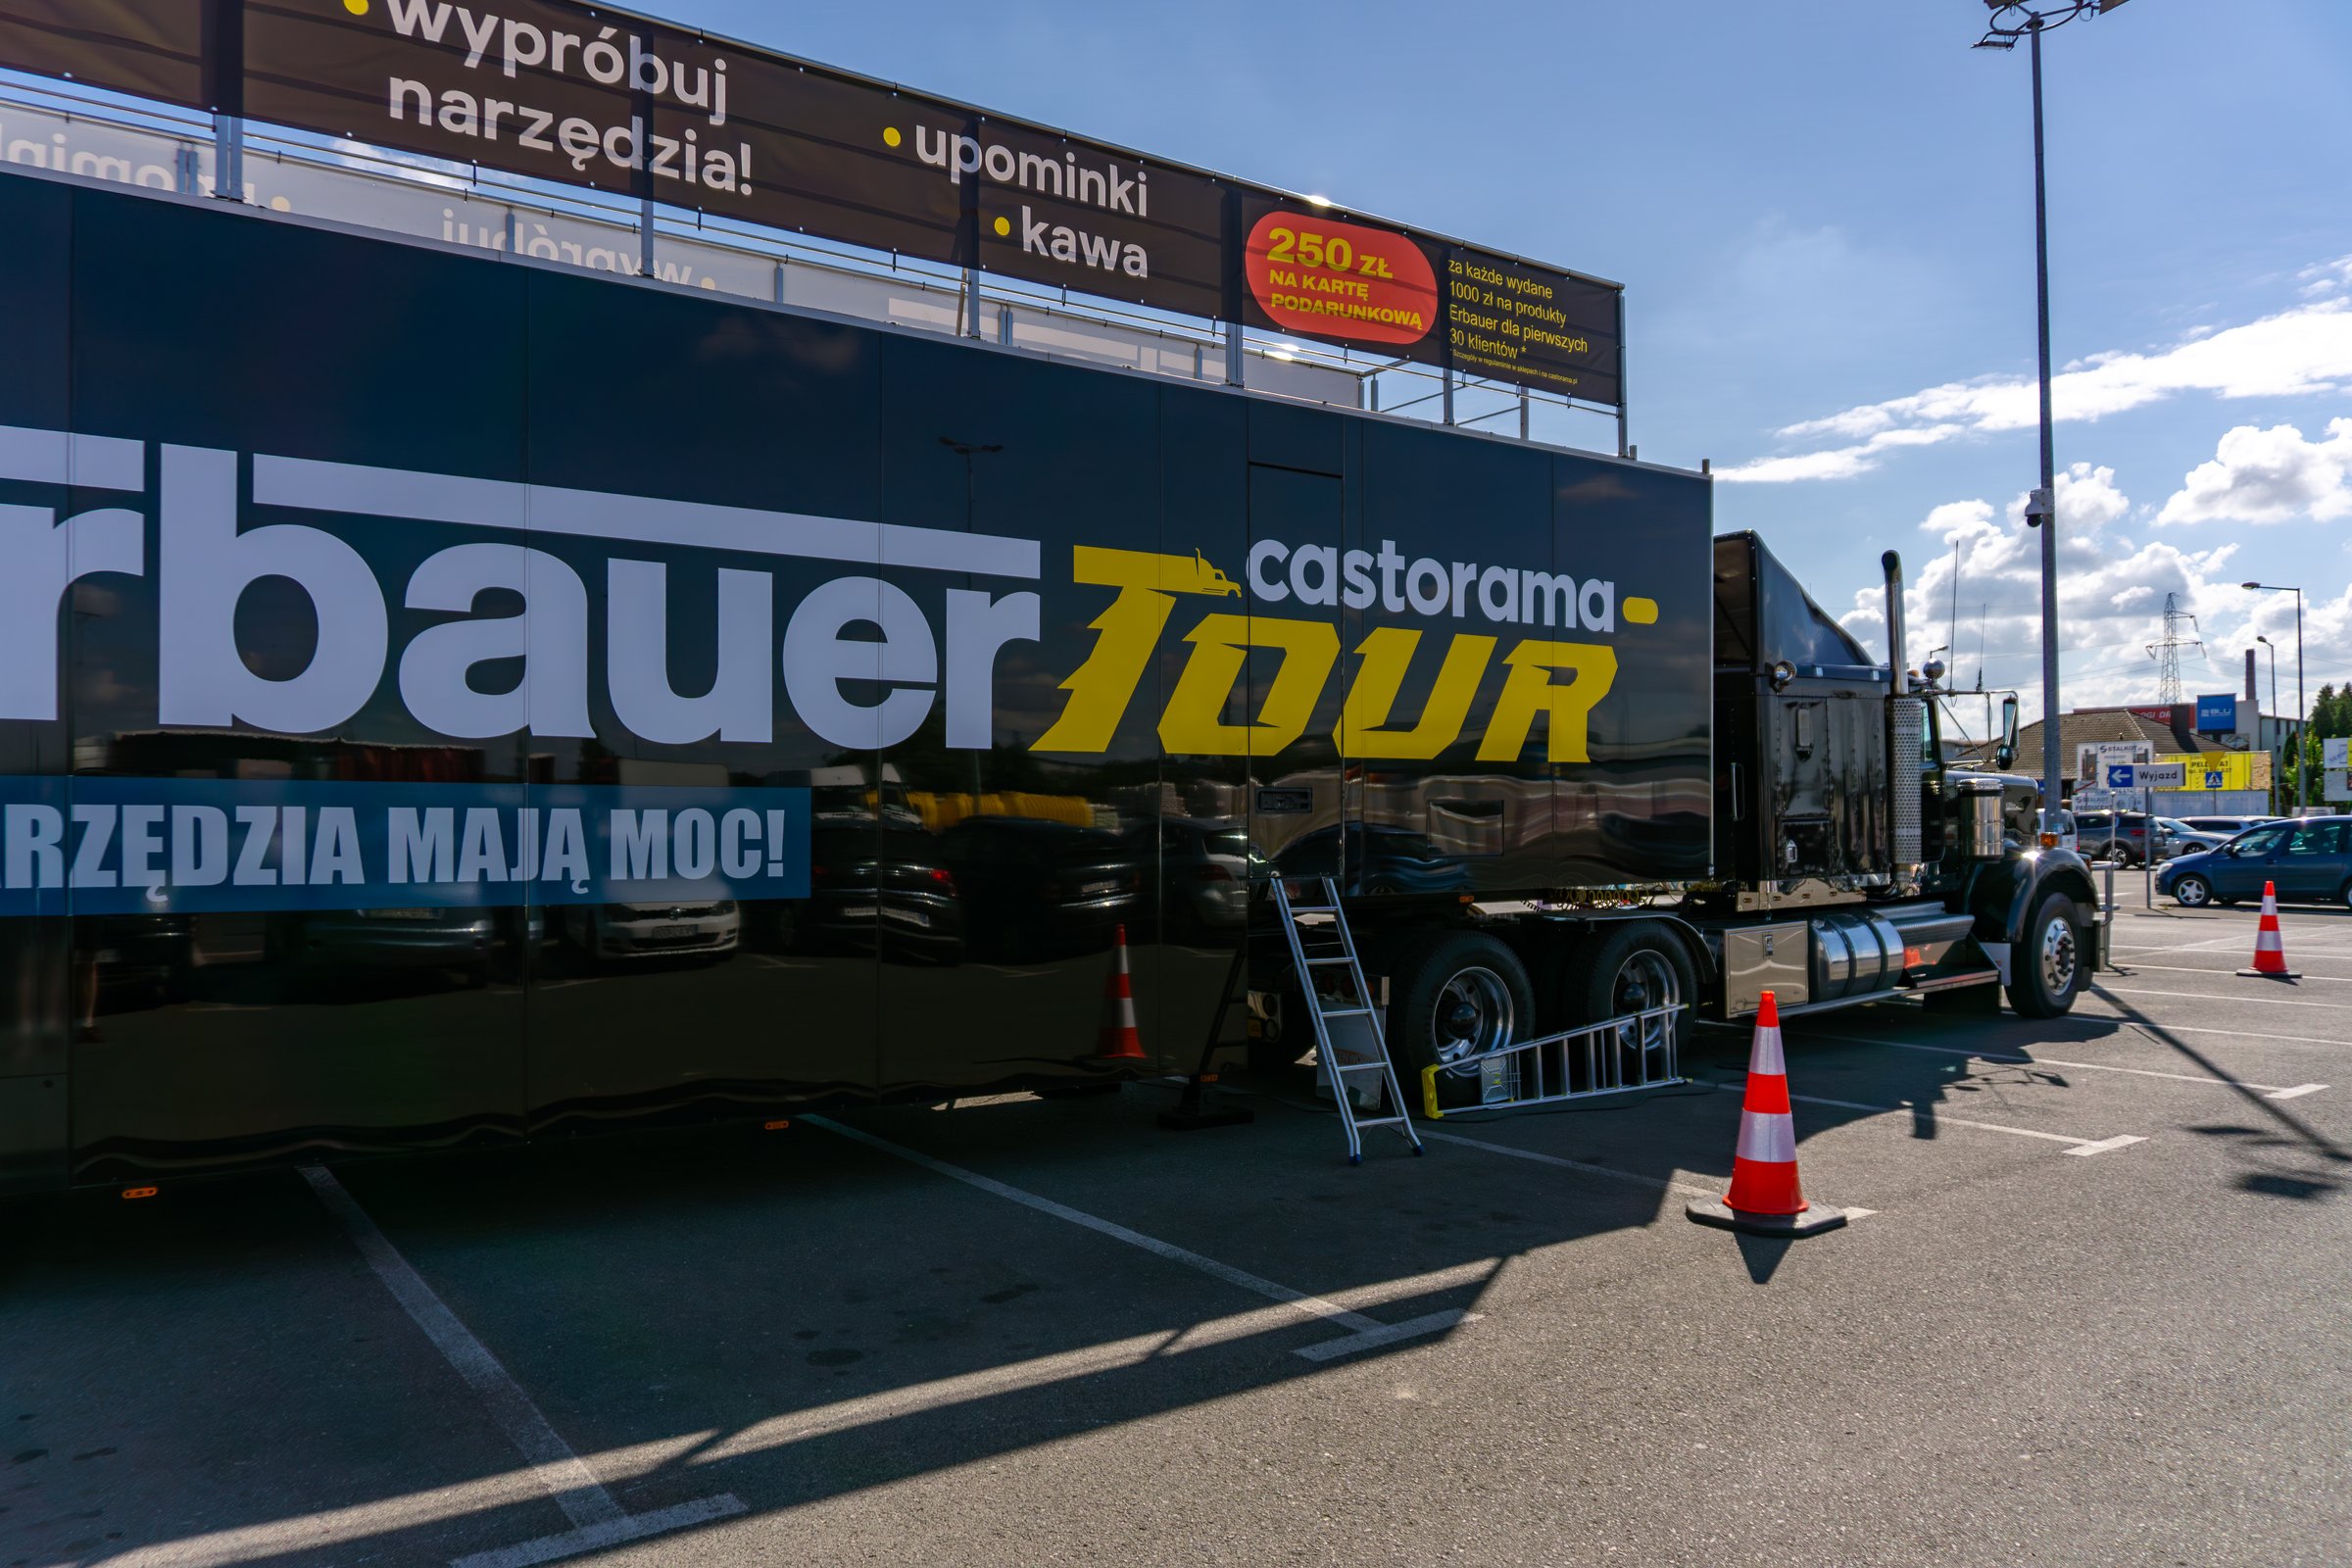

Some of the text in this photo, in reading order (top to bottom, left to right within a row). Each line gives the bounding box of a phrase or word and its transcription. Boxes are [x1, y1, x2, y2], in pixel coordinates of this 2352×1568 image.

[386, 0, 726, 125] wypróbuj
[389, 76, 753, 195] narzędzia!
[915, 124, 1148, 218] upominki
[1021, 205, 1149, 279] kawa
[1267, 227, 1394, 278] 250 ZŁ
[1269, 270, 1369, 301] NA KARTĘ
[1448, 259, 1553, 300] za każde wydane
[1449, 280, 1567, 328] 1000 zł na produkty
[1271, 292, 1423, 330] PODARUNKOWĄ
[1449, 304, 1589, 354] Erbauer dla pierwszych
[1449, 328, 1518, 360] 30 klientów
[1246, 539, 1616, 634] castorama
[1029, 545, 1619, 763] TOUR
[2139, 770, 2178, 782] Wyjazd
[0, 805, 785, 903] RZĘDZIA MAJĄ MOC!
